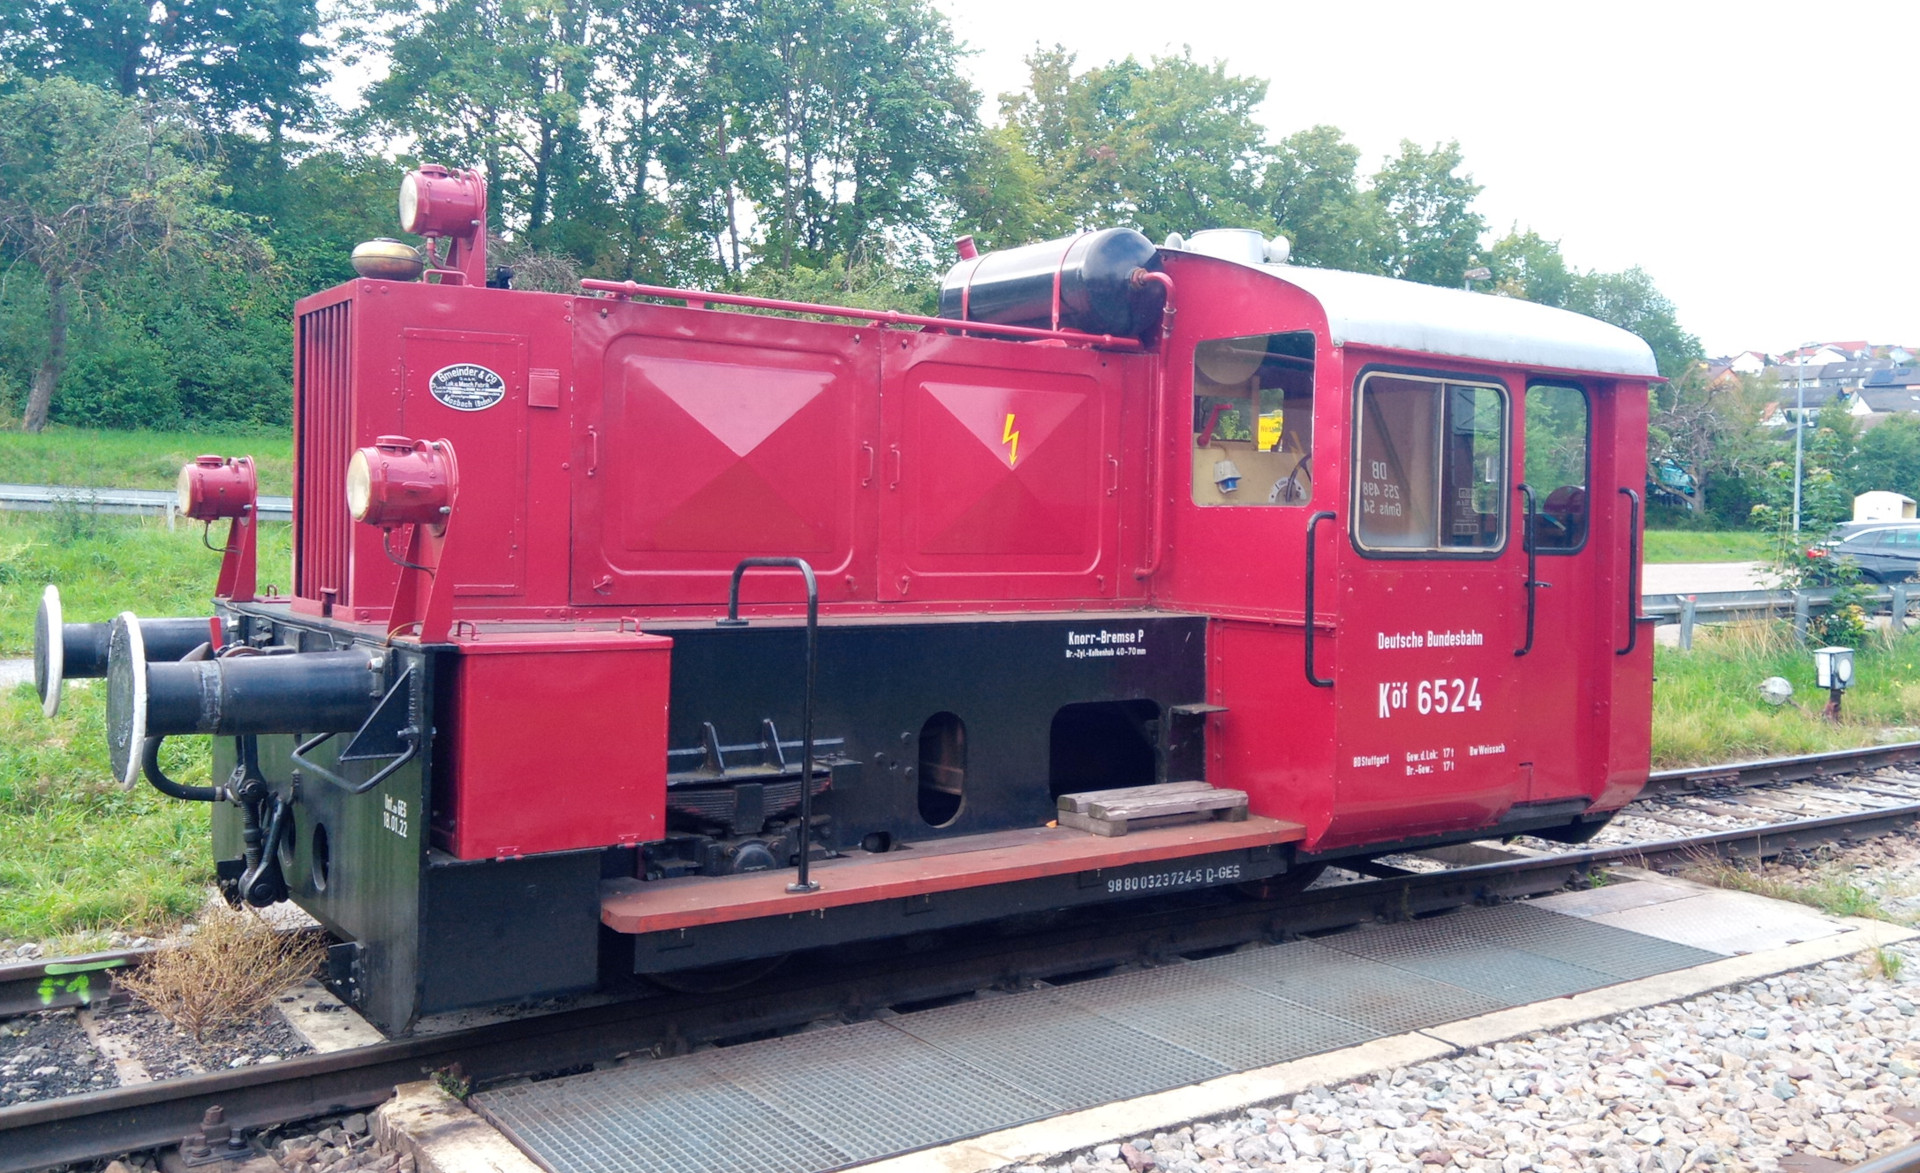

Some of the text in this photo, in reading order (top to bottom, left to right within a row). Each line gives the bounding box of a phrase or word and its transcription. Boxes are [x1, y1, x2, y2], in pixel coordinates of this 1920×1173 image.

[437, 366, 478, 383] Gmeinder
[478, 370, 485, 379] &
[443, 394, 473, 408] Mosbach
[1068, 629, 1144, 646] Knorr-Bremse P
[1378, 629, 1483, 650] Deutsche Bundesbahn
[1379, 677, 1482, 718] Köf 6524
[383, 811, 407, 838] 18.01.22
